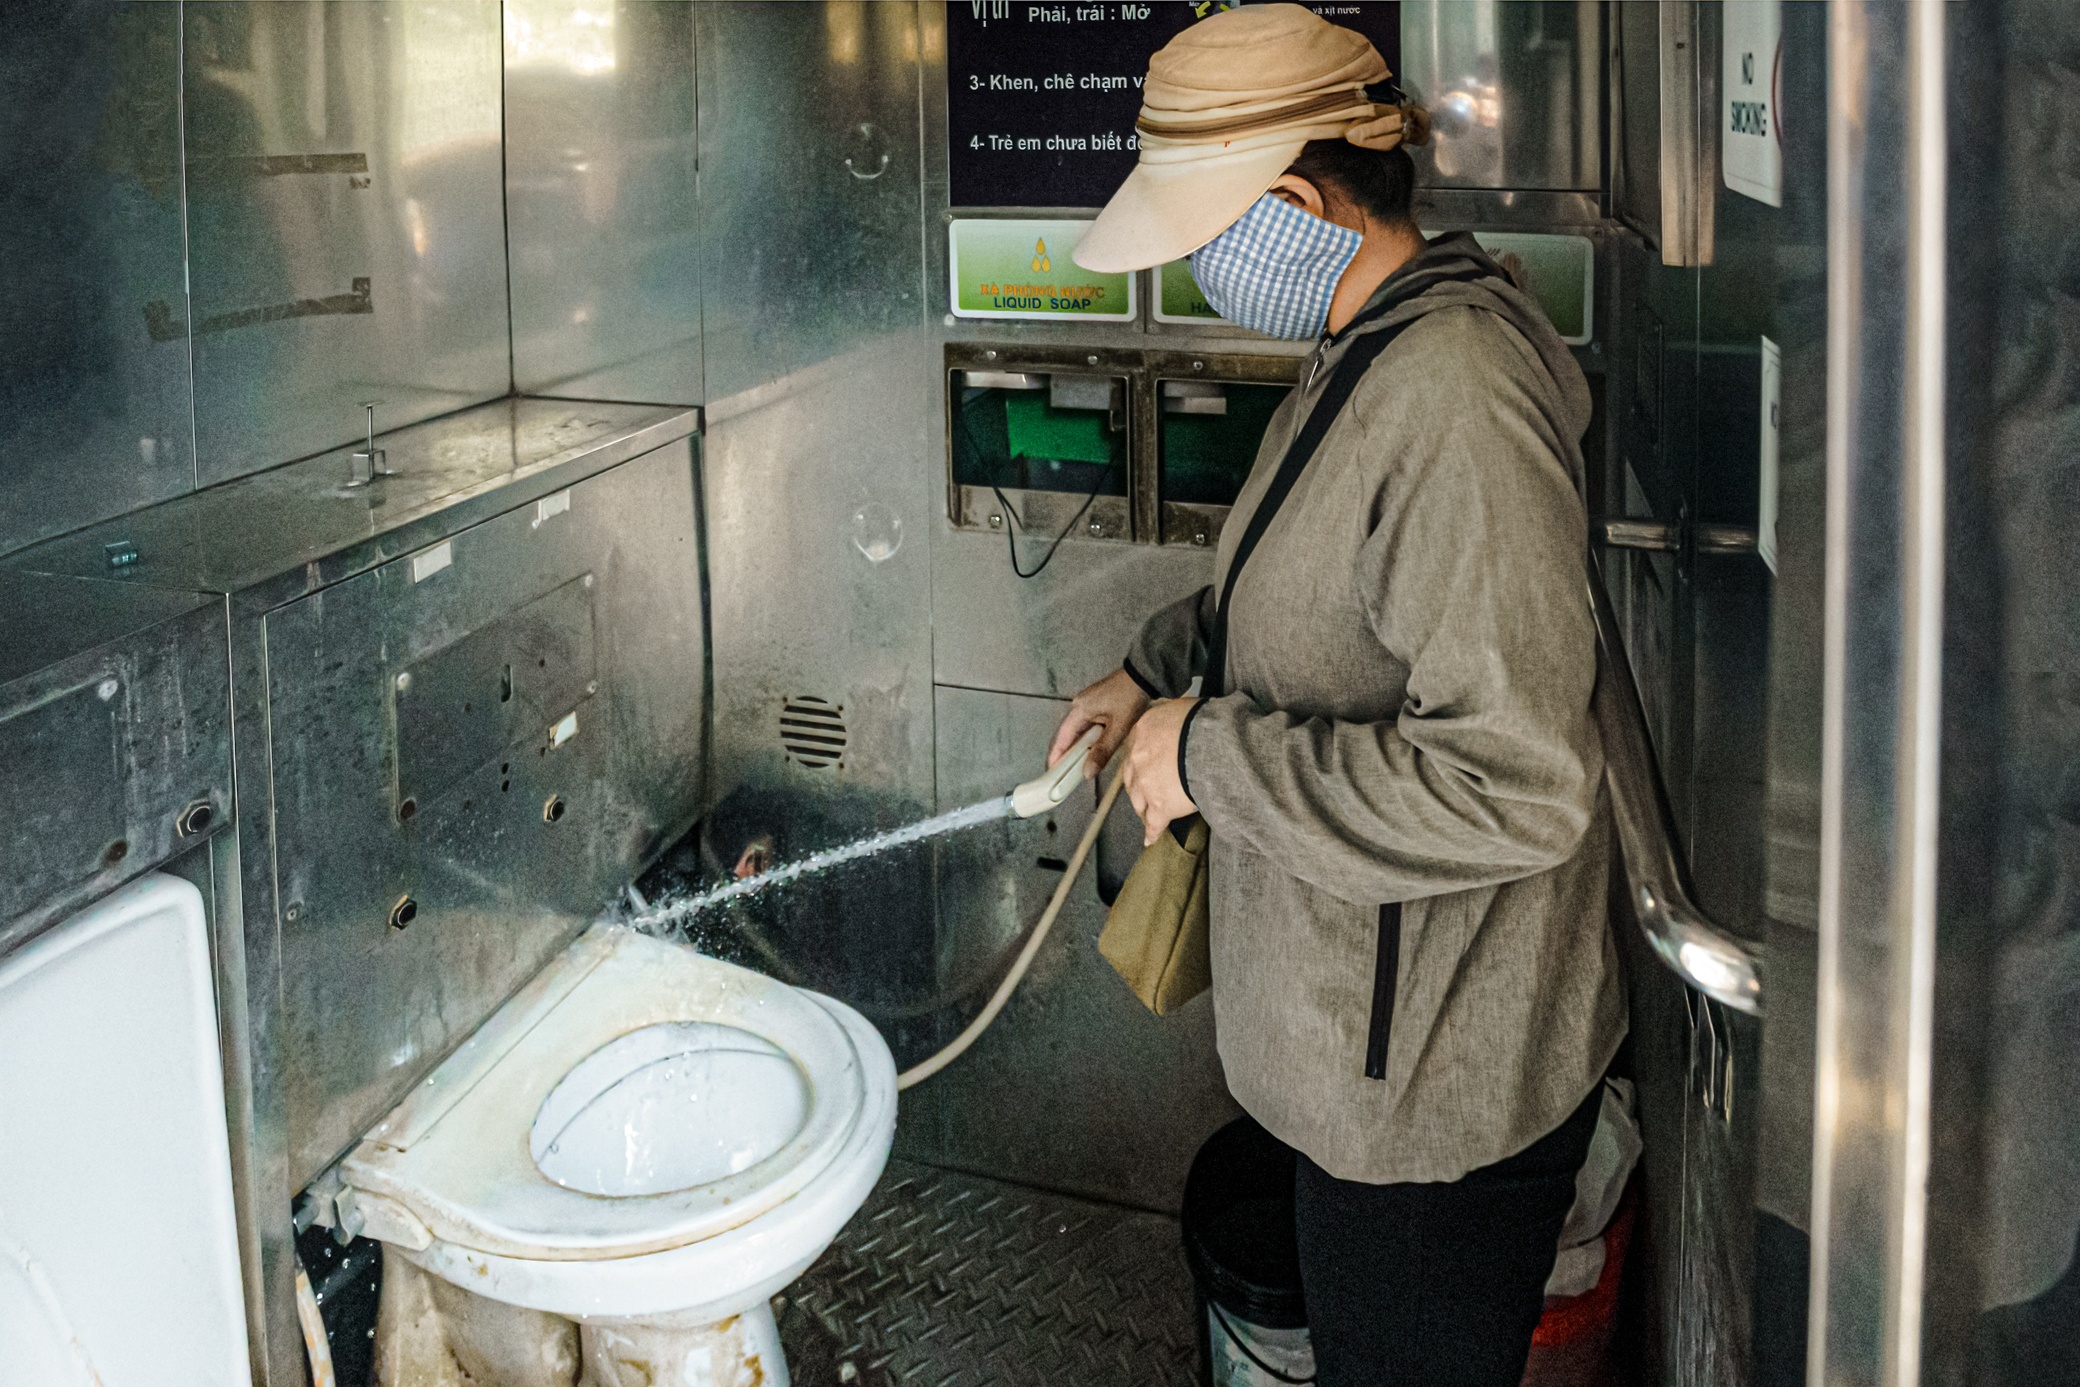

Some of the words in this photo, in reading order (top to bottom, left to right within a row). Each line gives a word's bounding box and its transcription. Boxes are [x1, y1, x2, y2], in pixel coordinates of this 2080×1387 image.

[1028, 6, 1071, 24] Phải,
[1077, 4, 1105, 21] trái
[1122, 4, 1151, 20] Mở
[1312, 6, 1323, 15] và
[1337, 5, 1361, 15] nước
[1742, 52, 1754, 86] NO
[969, 75, 986, 90] 3-
[990, 74, 1038, 92] Khen,
[1044, 73, 1075, 89] chê
[1080, 73, 1128, 92] chạm
[1133, 76, 1146, 89] v
[1731, 101, 1767, 137] SMOKING
[970, 135, 985, 150] 4-
[989, 133, 1014, 150] Trẻ
[1018, 137, 1041, 150] em
[1046, 134, 1087, 150] chưa
[1092, 131, 1122, 150] biết
[994, 297, 1041, 309] LIQUID
[1050, 298, 1091, 310] SOAP
[1191, 302, 1214, 314] HA
